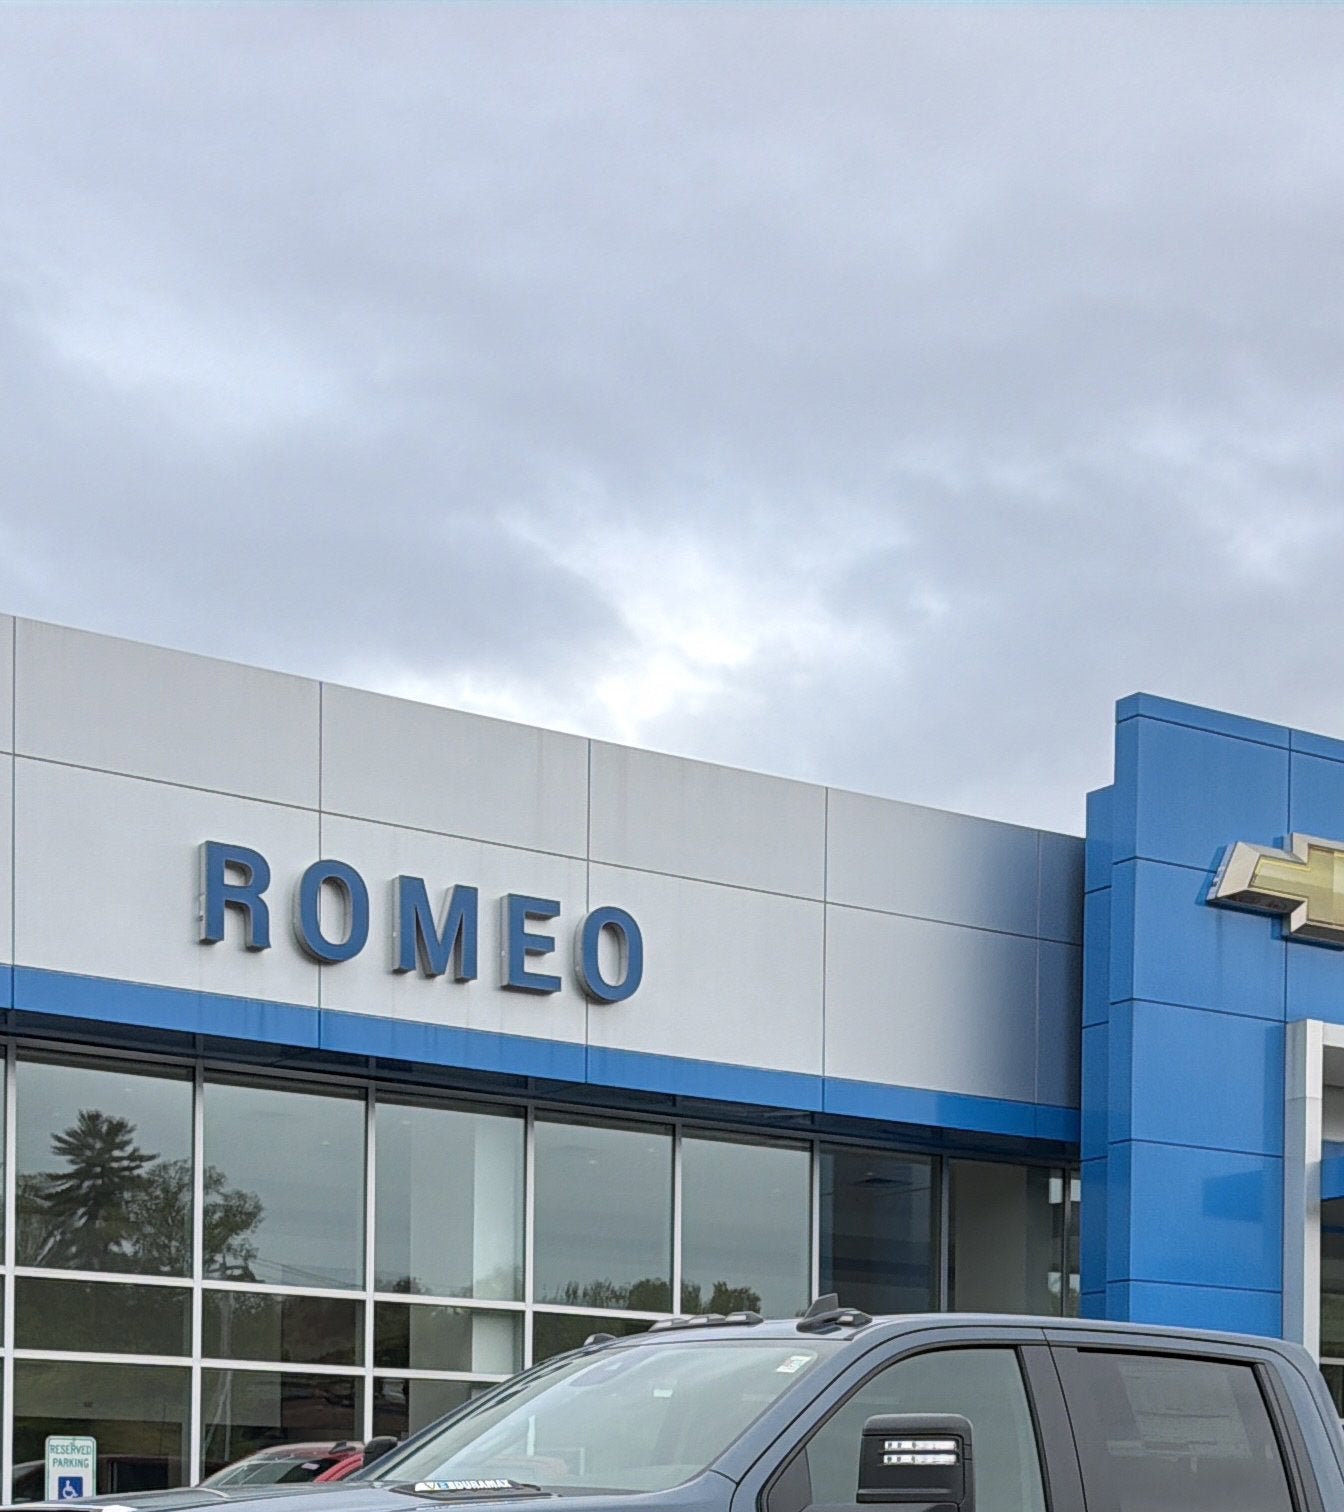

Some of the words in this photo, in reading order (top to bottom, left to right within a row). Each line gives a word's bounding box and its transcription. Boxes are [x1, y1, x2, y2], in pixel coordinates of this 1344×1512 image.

[198, 840, 644, 1005] ROMEO
[49, 1444, 91, 1455] RESERVED
[52, 1458, 89, 1468] PARKING
[454, 1479, 513, 1490] DURAMAX
